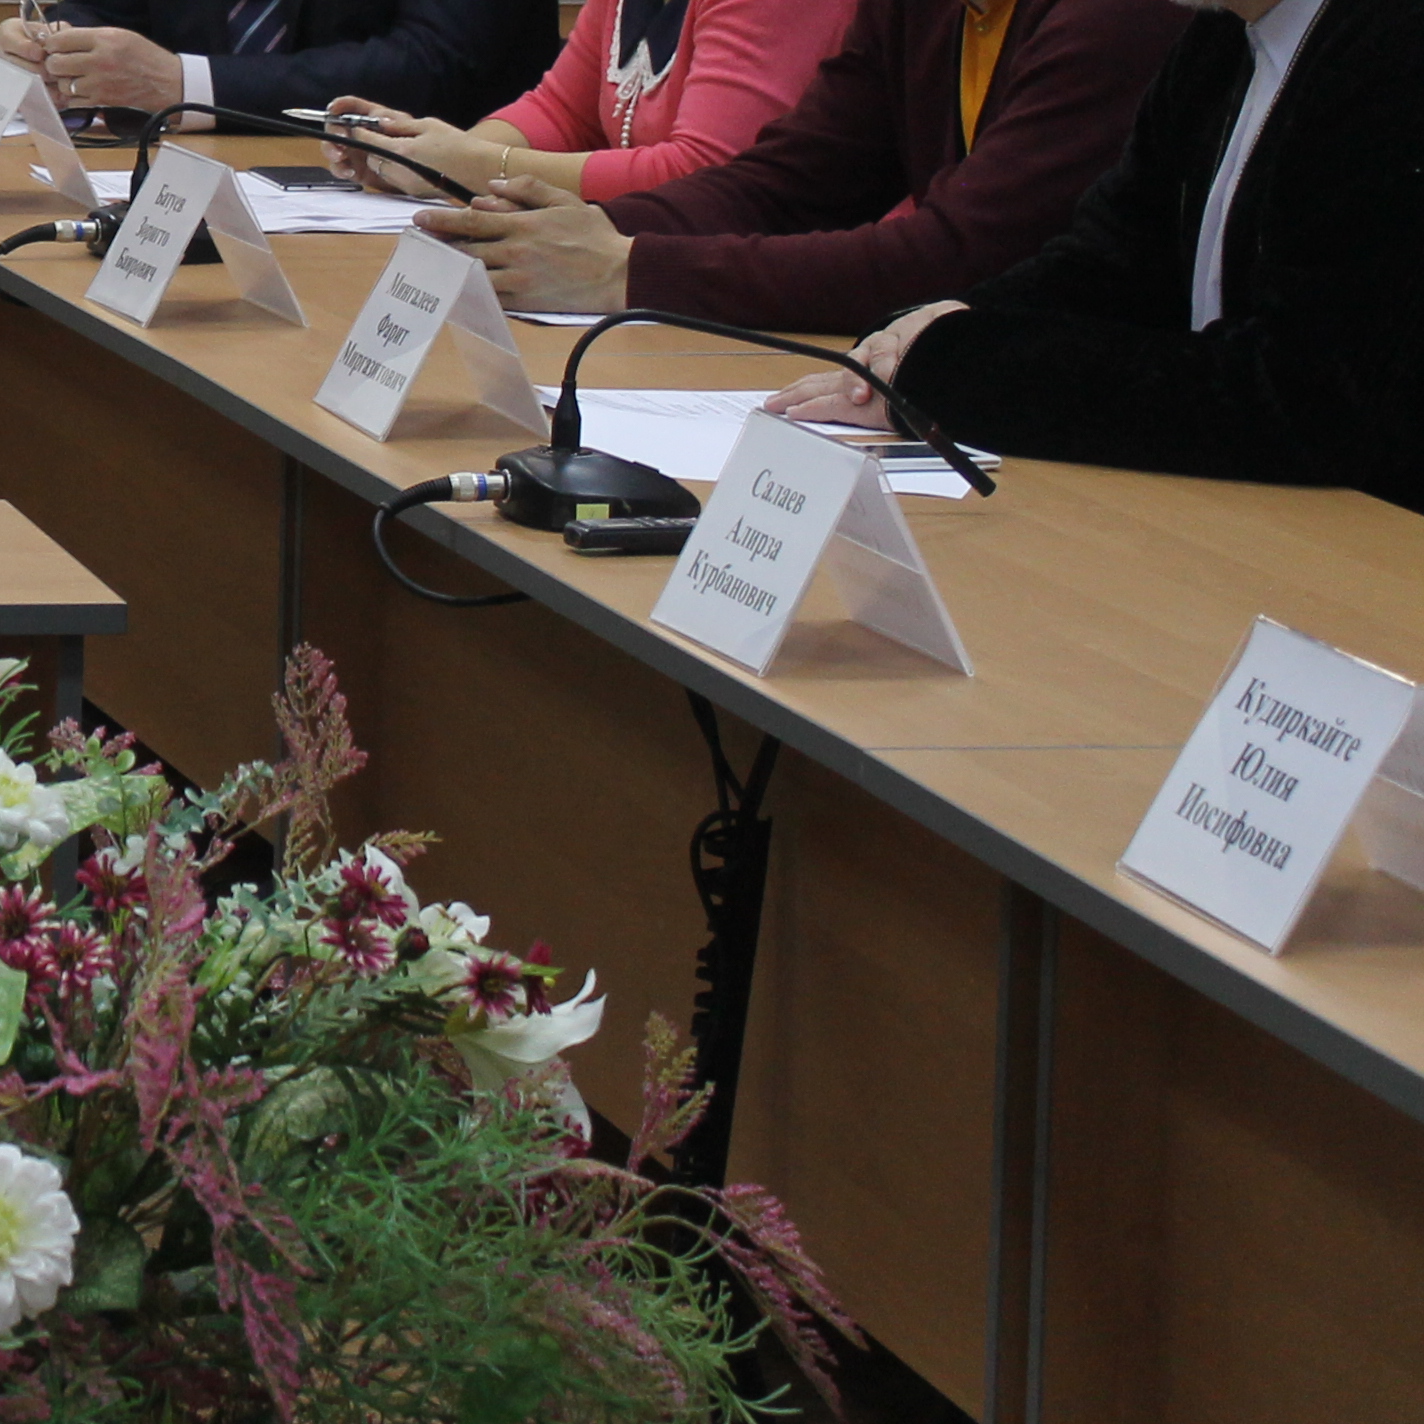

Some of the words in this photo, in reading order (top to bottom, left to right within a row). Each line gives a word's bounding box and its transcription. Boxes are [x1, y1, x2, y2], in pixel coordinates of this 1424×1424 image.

[385, 272, 440, 314] Мингалеев
[376, 313, 410, 347] Фарит
[751, 468, 807, 515] Салаев
[725, 515, 783, 562] Алирза
[687, 548, 778, 617] Курбанович
[1235, 677, 1361, 762] Кудиркайте
[1229, 742, 1299, 803] Юлия
[1174, 782, 1293, 871] Иосифовна
